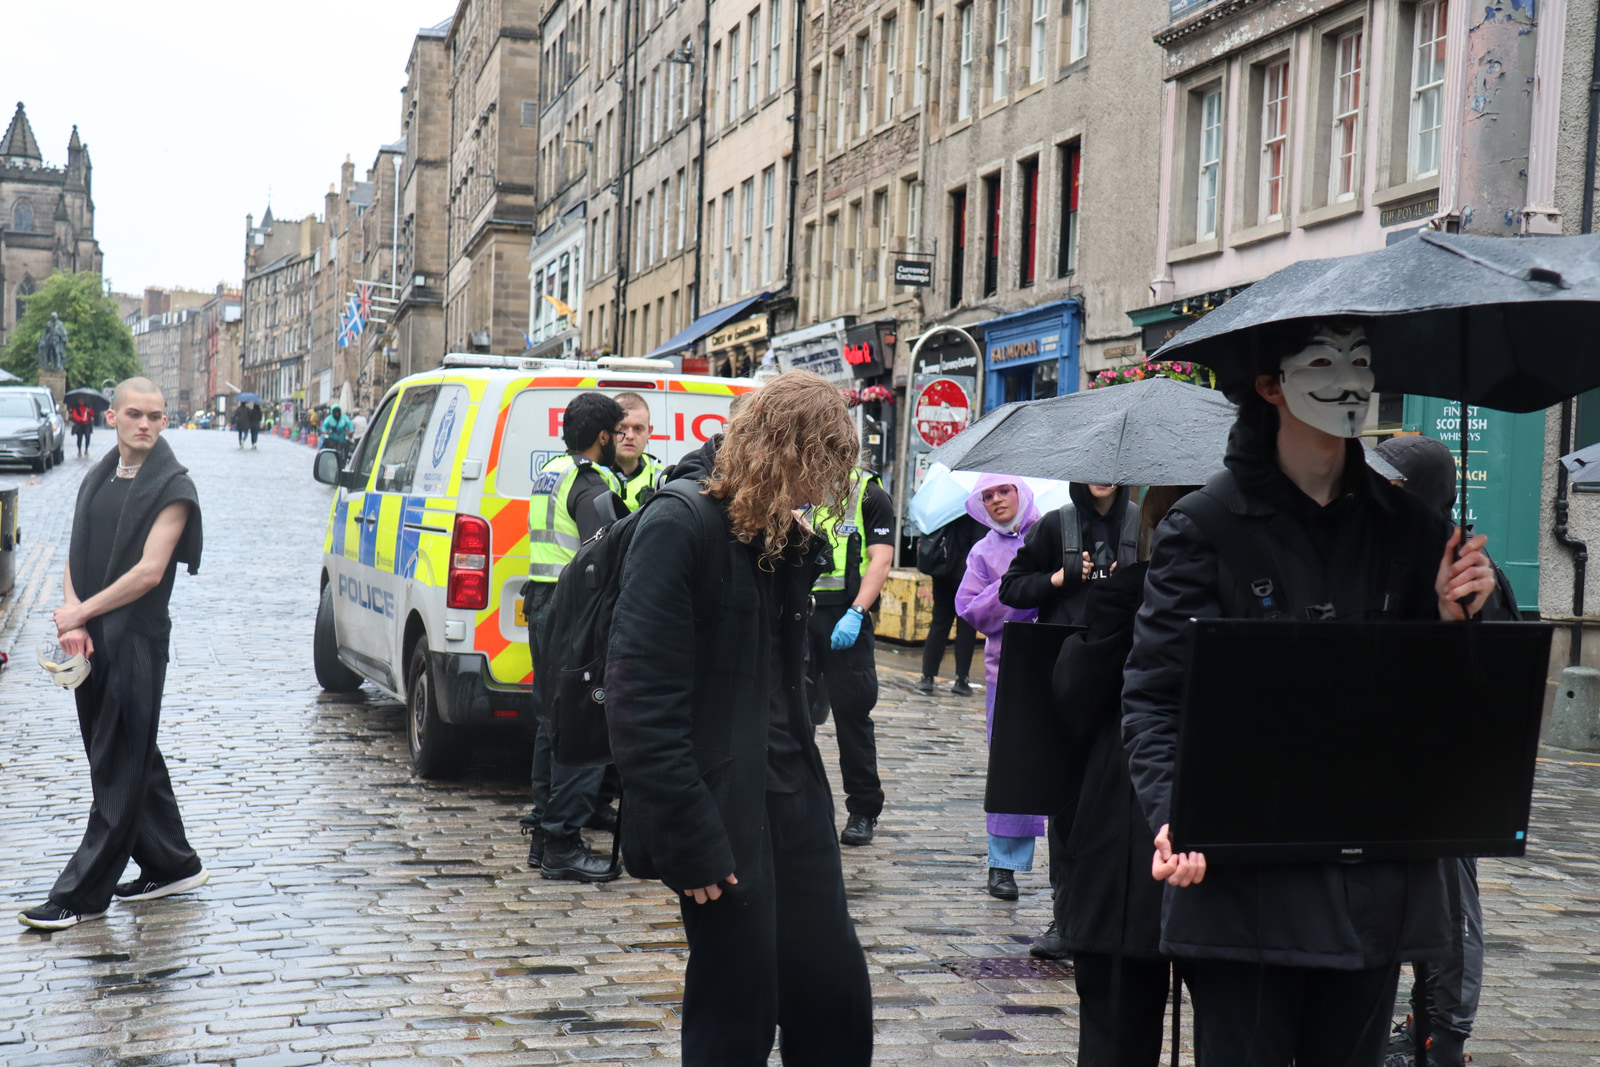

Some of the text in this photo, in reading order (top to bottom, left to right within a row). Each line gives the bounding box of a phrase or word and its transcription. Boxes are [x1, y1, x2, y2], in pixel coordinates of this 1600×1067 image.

[1382, 199, 1438, 224] THE ROYAL MIL
[897, 265, 930, 275] Currency
[896, 273, 930, 283] Exchange
[991, 338, 1039, 363] BALMORAL
[1443, 406, 1480, 417] FINST
[1436, 418, 1488, 430] SCOTISH
[339, 573, 394, 620] POLICE
